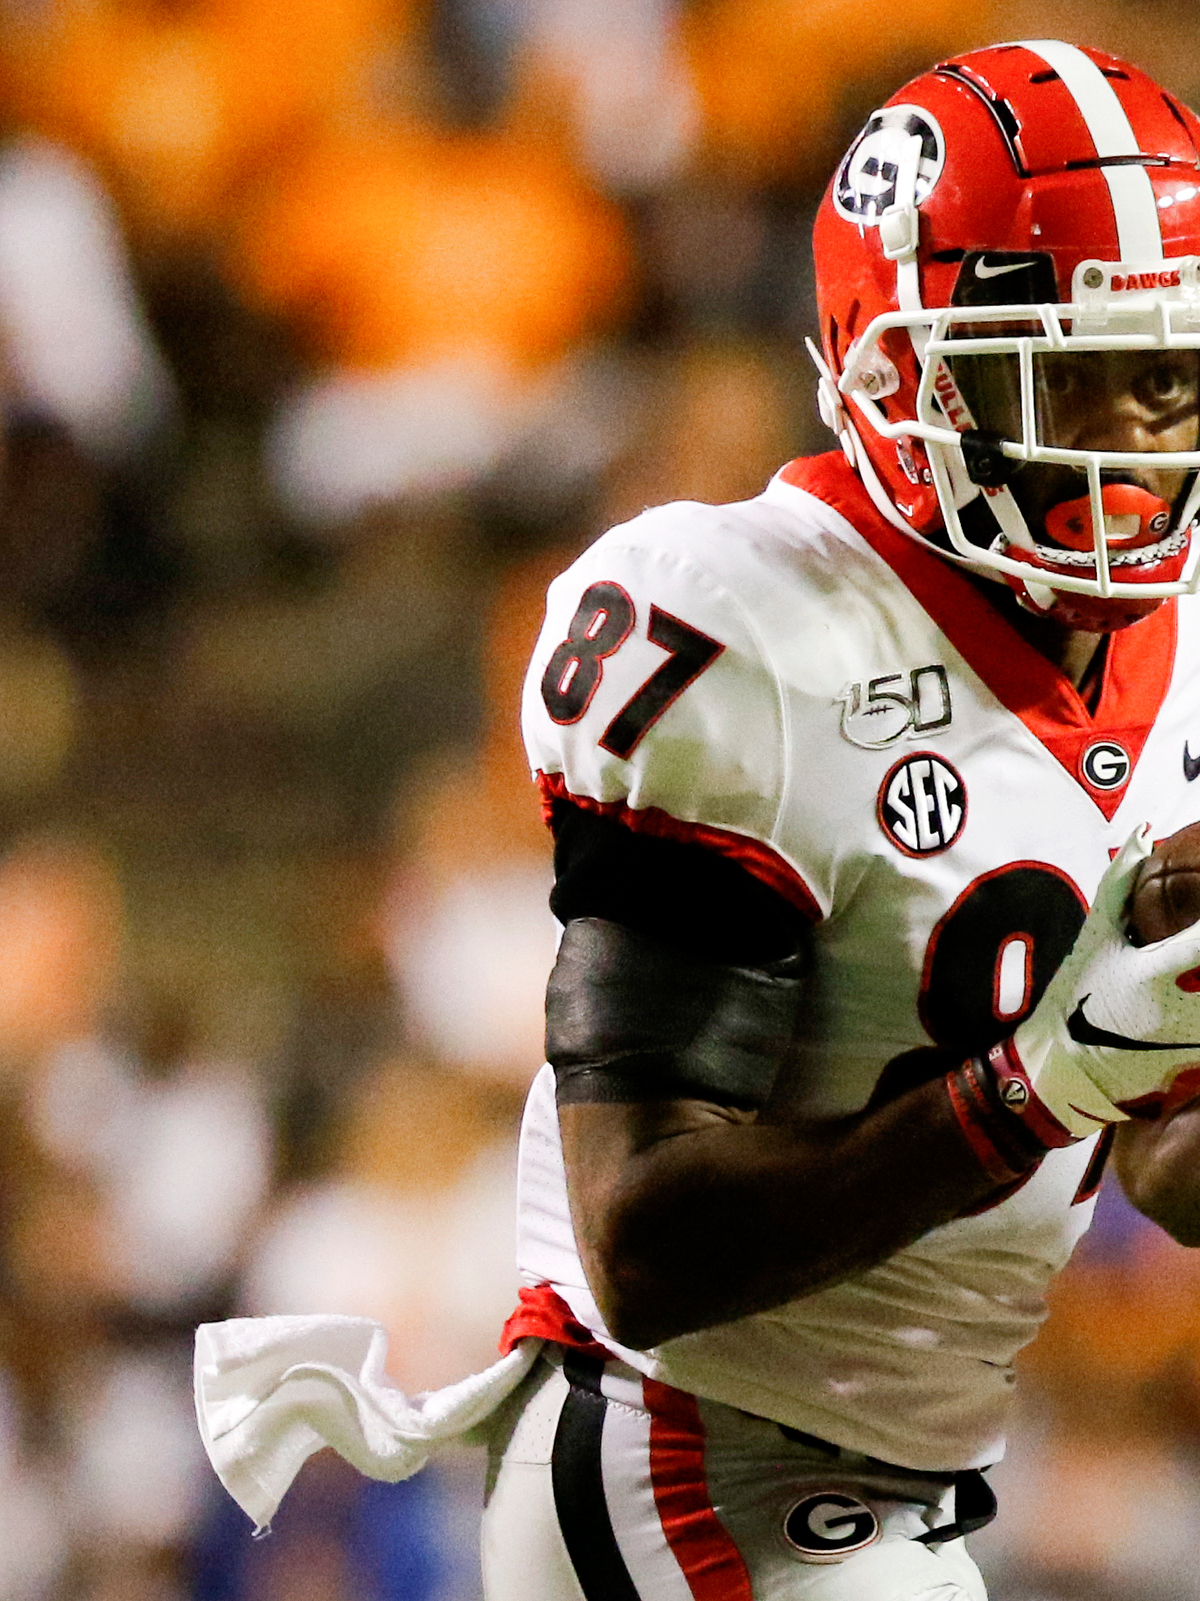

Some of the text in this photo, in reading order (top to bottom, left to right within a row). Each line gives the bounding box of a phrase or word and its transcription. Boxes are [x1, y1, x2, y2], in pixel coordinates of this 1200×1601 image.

[541, 580, 726, 761] 87
[839, 664, 952, 748] 150
[886, 758, 963, 851] SEC
[1084, 744, 1128, 787] G
[785, 1492, 877, 1552] G
